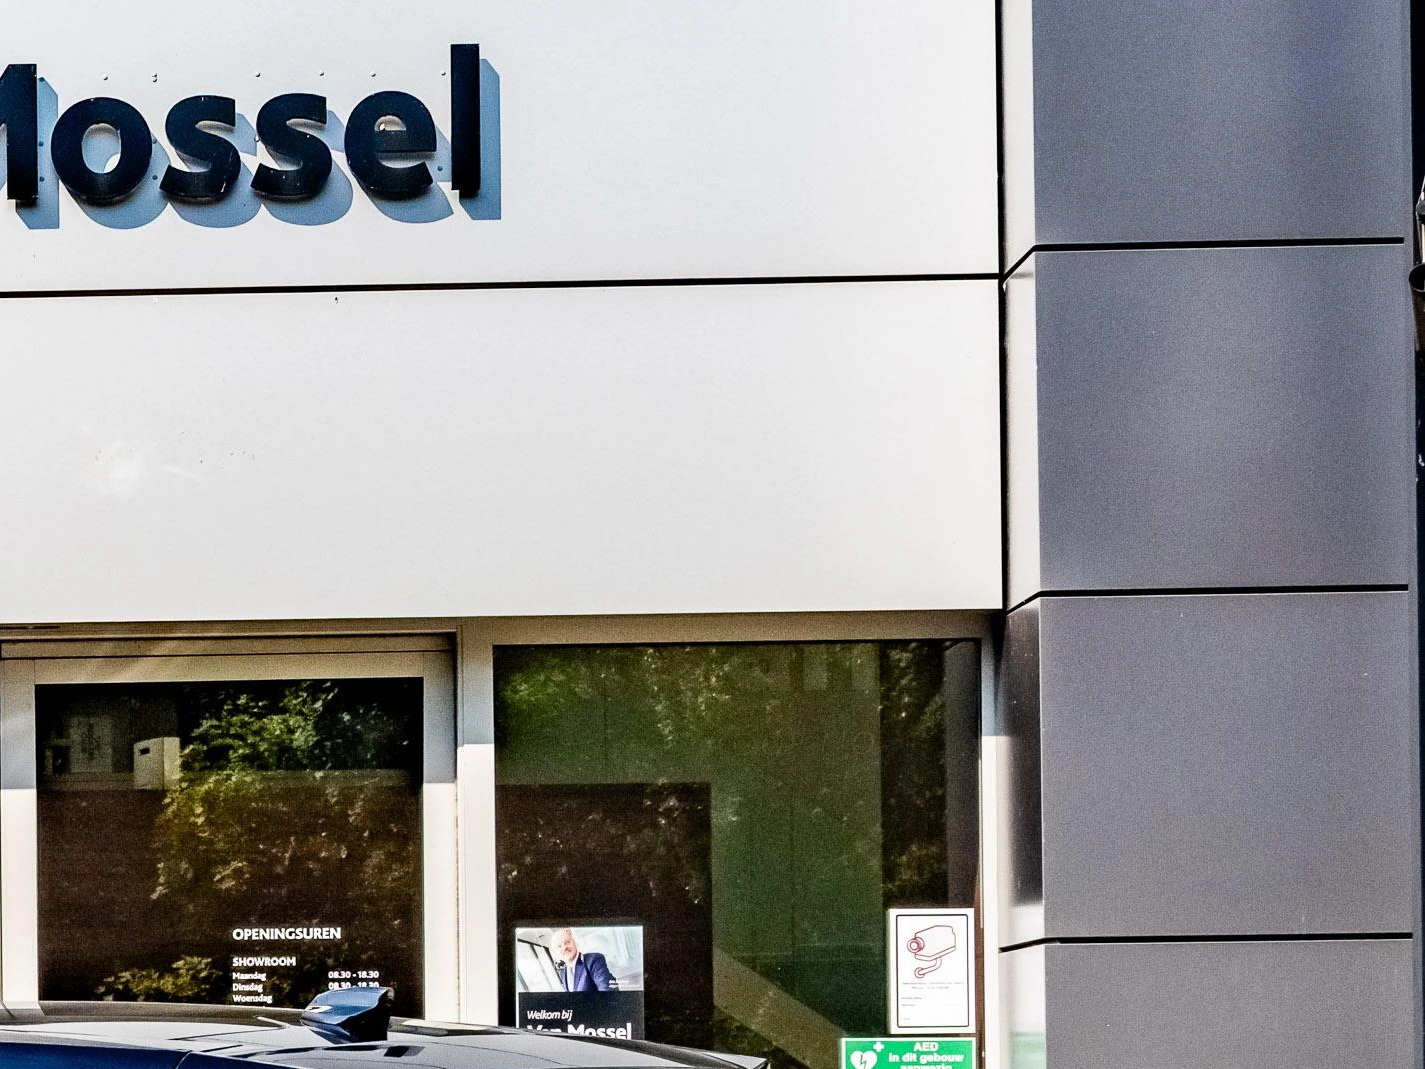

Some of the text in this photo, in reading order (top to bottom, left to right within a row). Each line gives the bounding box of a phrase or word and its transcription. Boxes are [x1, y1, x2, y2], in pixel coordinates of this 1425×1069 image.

[232, 927, 342, 941] OPENINGSUREN
[232, 956, 297, 967] SHOWROOM
[232, 971, 267, 981] Maandag
[328, 971, 351, 979] 08.30
[358, 970, 379, 979] 18.30
[232, 983, 263, 993] Dinsdag
[232, 994, 273, 1004] Woensdag
[526, 1009, 573, 1022] Welkom bij
[914, 1041, 939, 1052] AED
[901, 1052, 917, 1062] dit
[919, 1053, 964, 1065] gebouw
